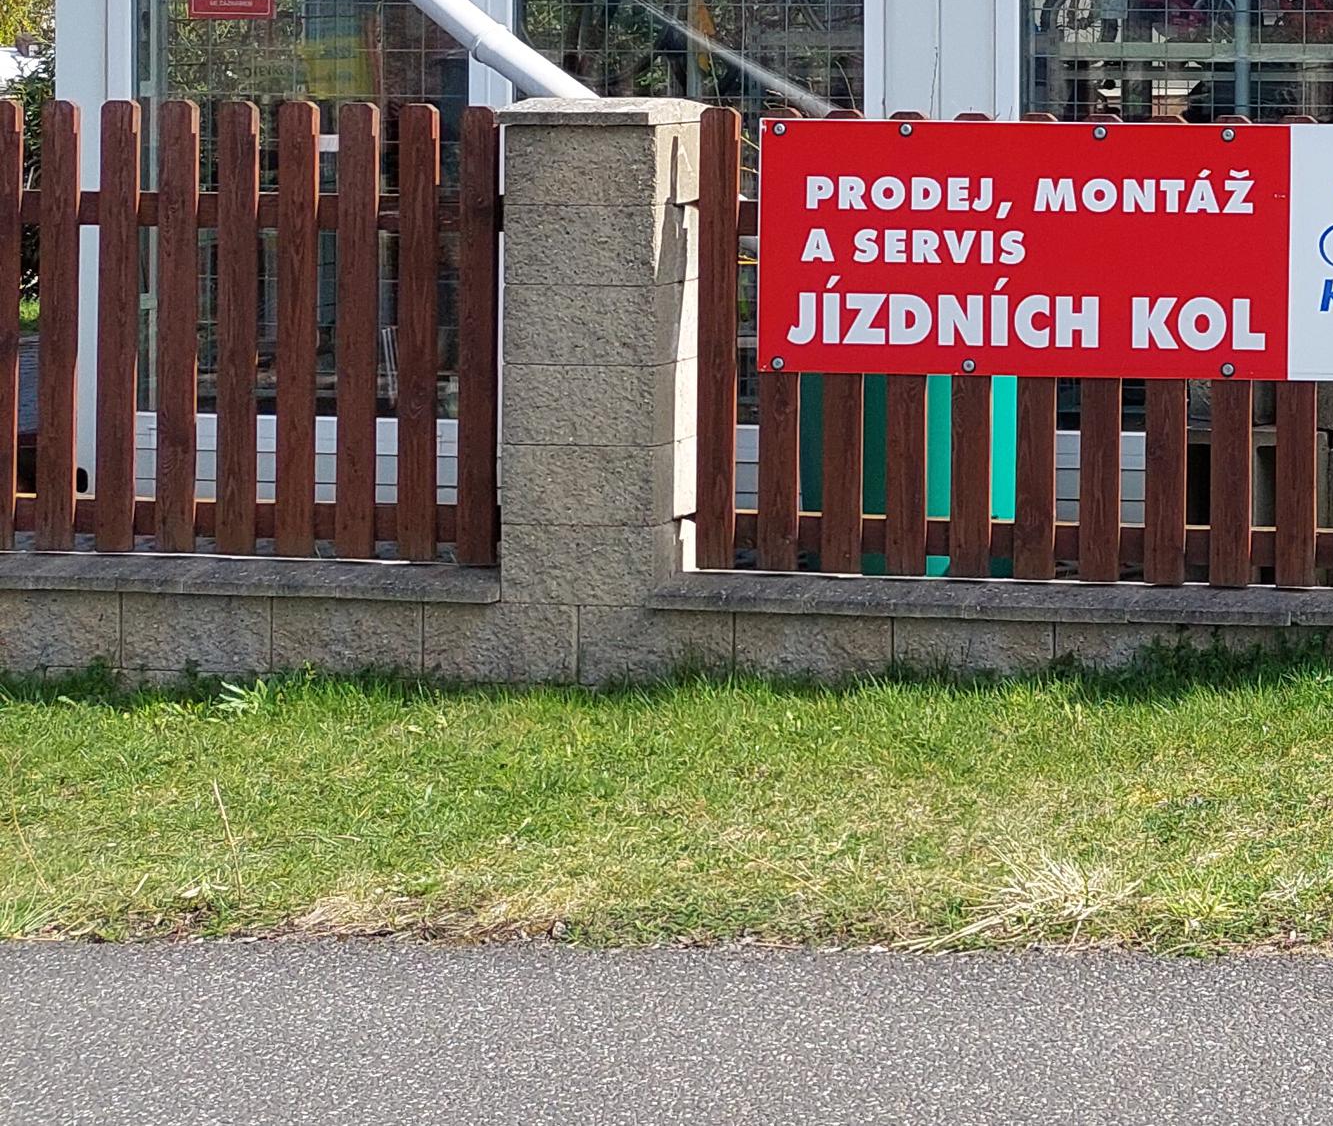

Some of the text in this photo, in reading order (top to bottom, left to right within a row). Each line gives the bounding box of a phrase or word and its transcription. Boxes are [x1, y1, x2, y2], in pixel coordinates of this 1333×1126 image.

[806, 169, 1255, 220] PRODEJ, MONTÁŽ
[801, 228, 1026, 265] A SERVIS
[786, 276, 1266, 351] JÍZDNÍCH KOL
